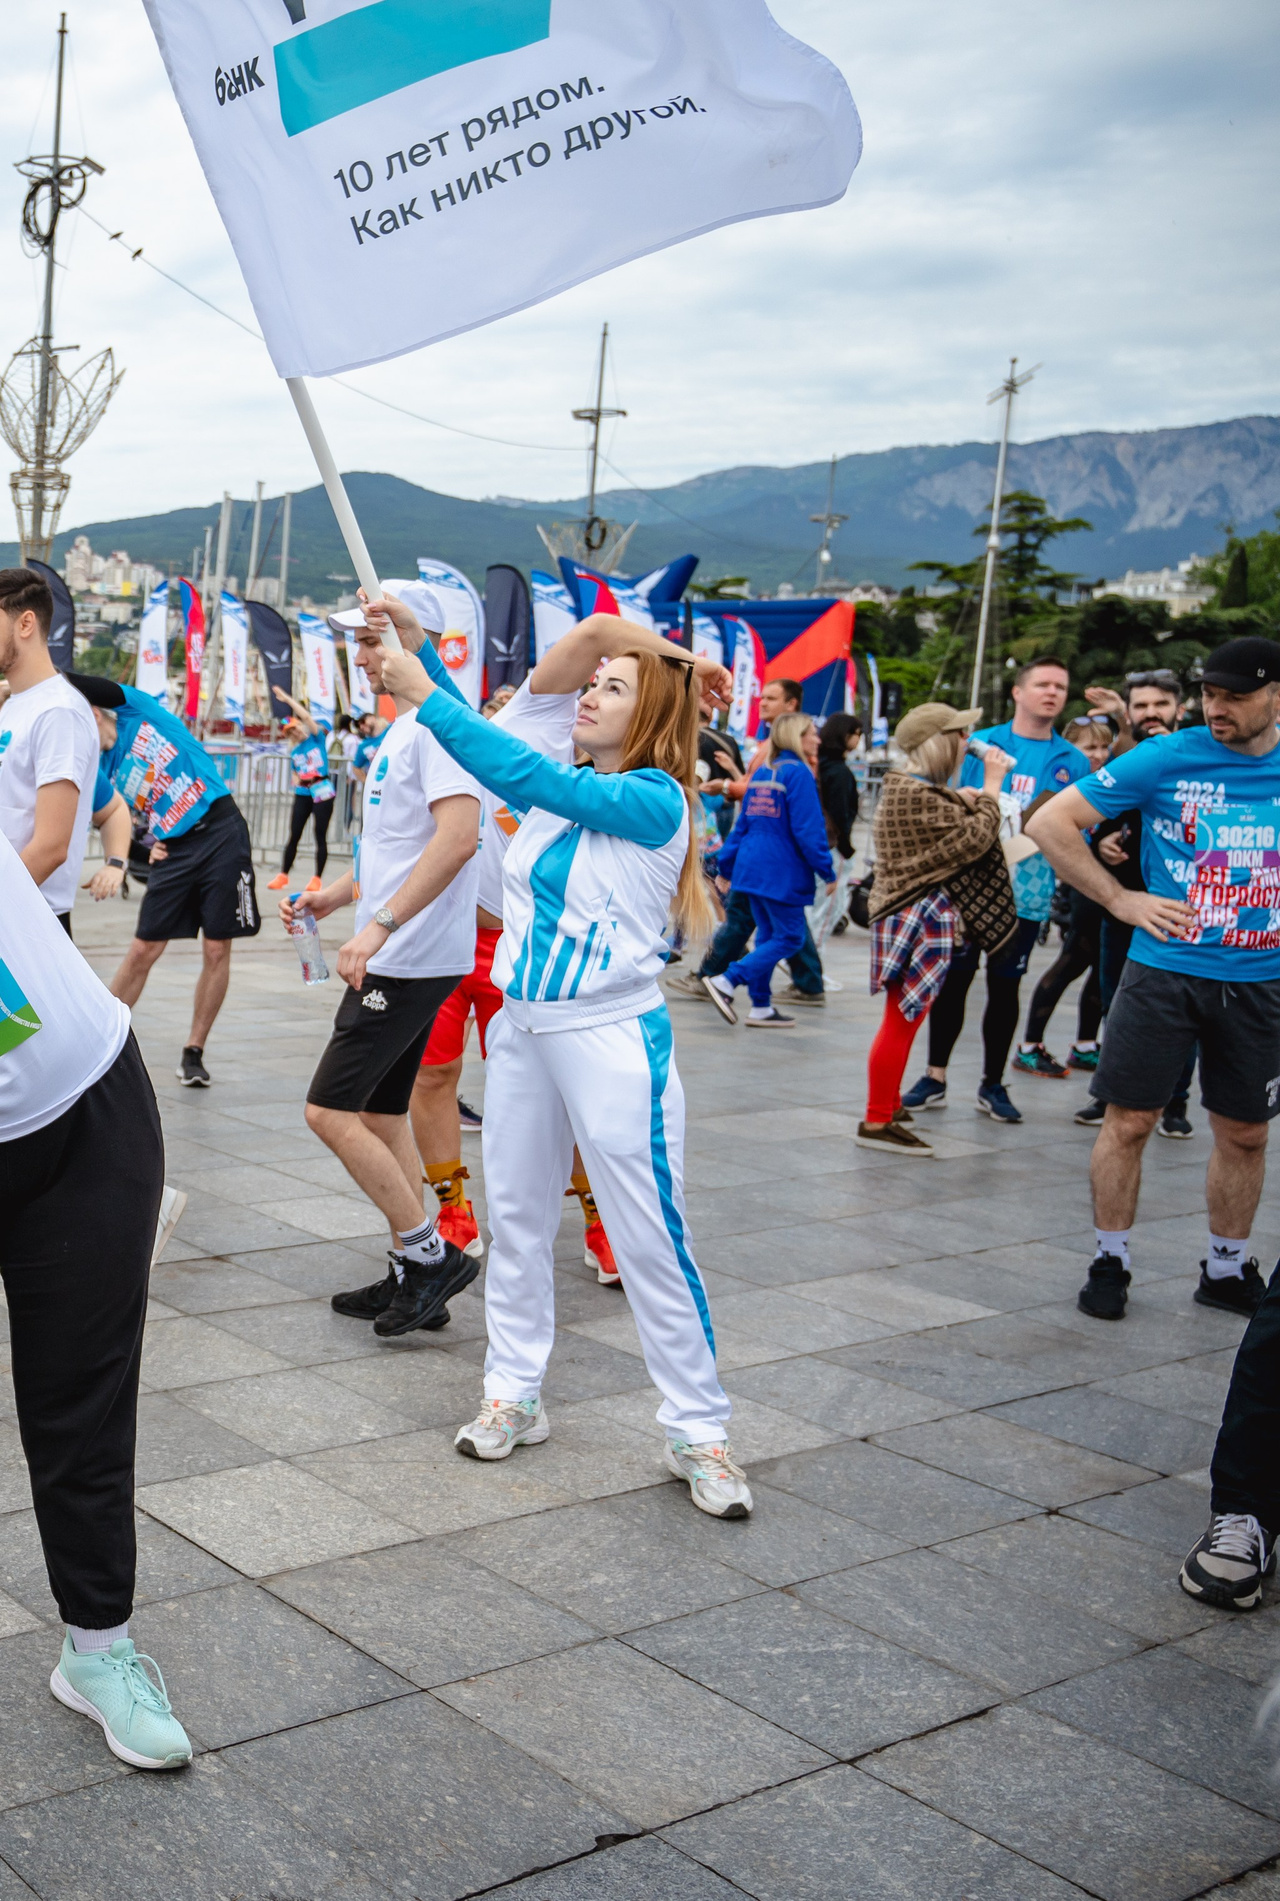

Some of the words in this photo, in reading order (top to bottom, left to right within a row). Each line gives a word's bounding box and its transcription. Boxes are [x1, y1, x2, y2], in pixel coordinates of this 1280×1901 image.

[333, 160, 375, 200] 10
[385, 131, 450, 181] лет
[461, 76, 606, 152] рядом.
[350, 196, 424, 246] Как
[431, 142, 552, 213] никто
[563, 95, 708, 160] другой.
[166, 770, 194, 803] 2024
[1173, 779, 1226, 807] 2024
[1152, 818, 1197, 845] #ЗАБ
[1216, 825, 1276, 849] 30216
[1226, 849, 1264, 869] 10КМ
[1187, 883, 1280, 909] #ГОРДОСТ
[361, 996, 386, 1011] Kappa
